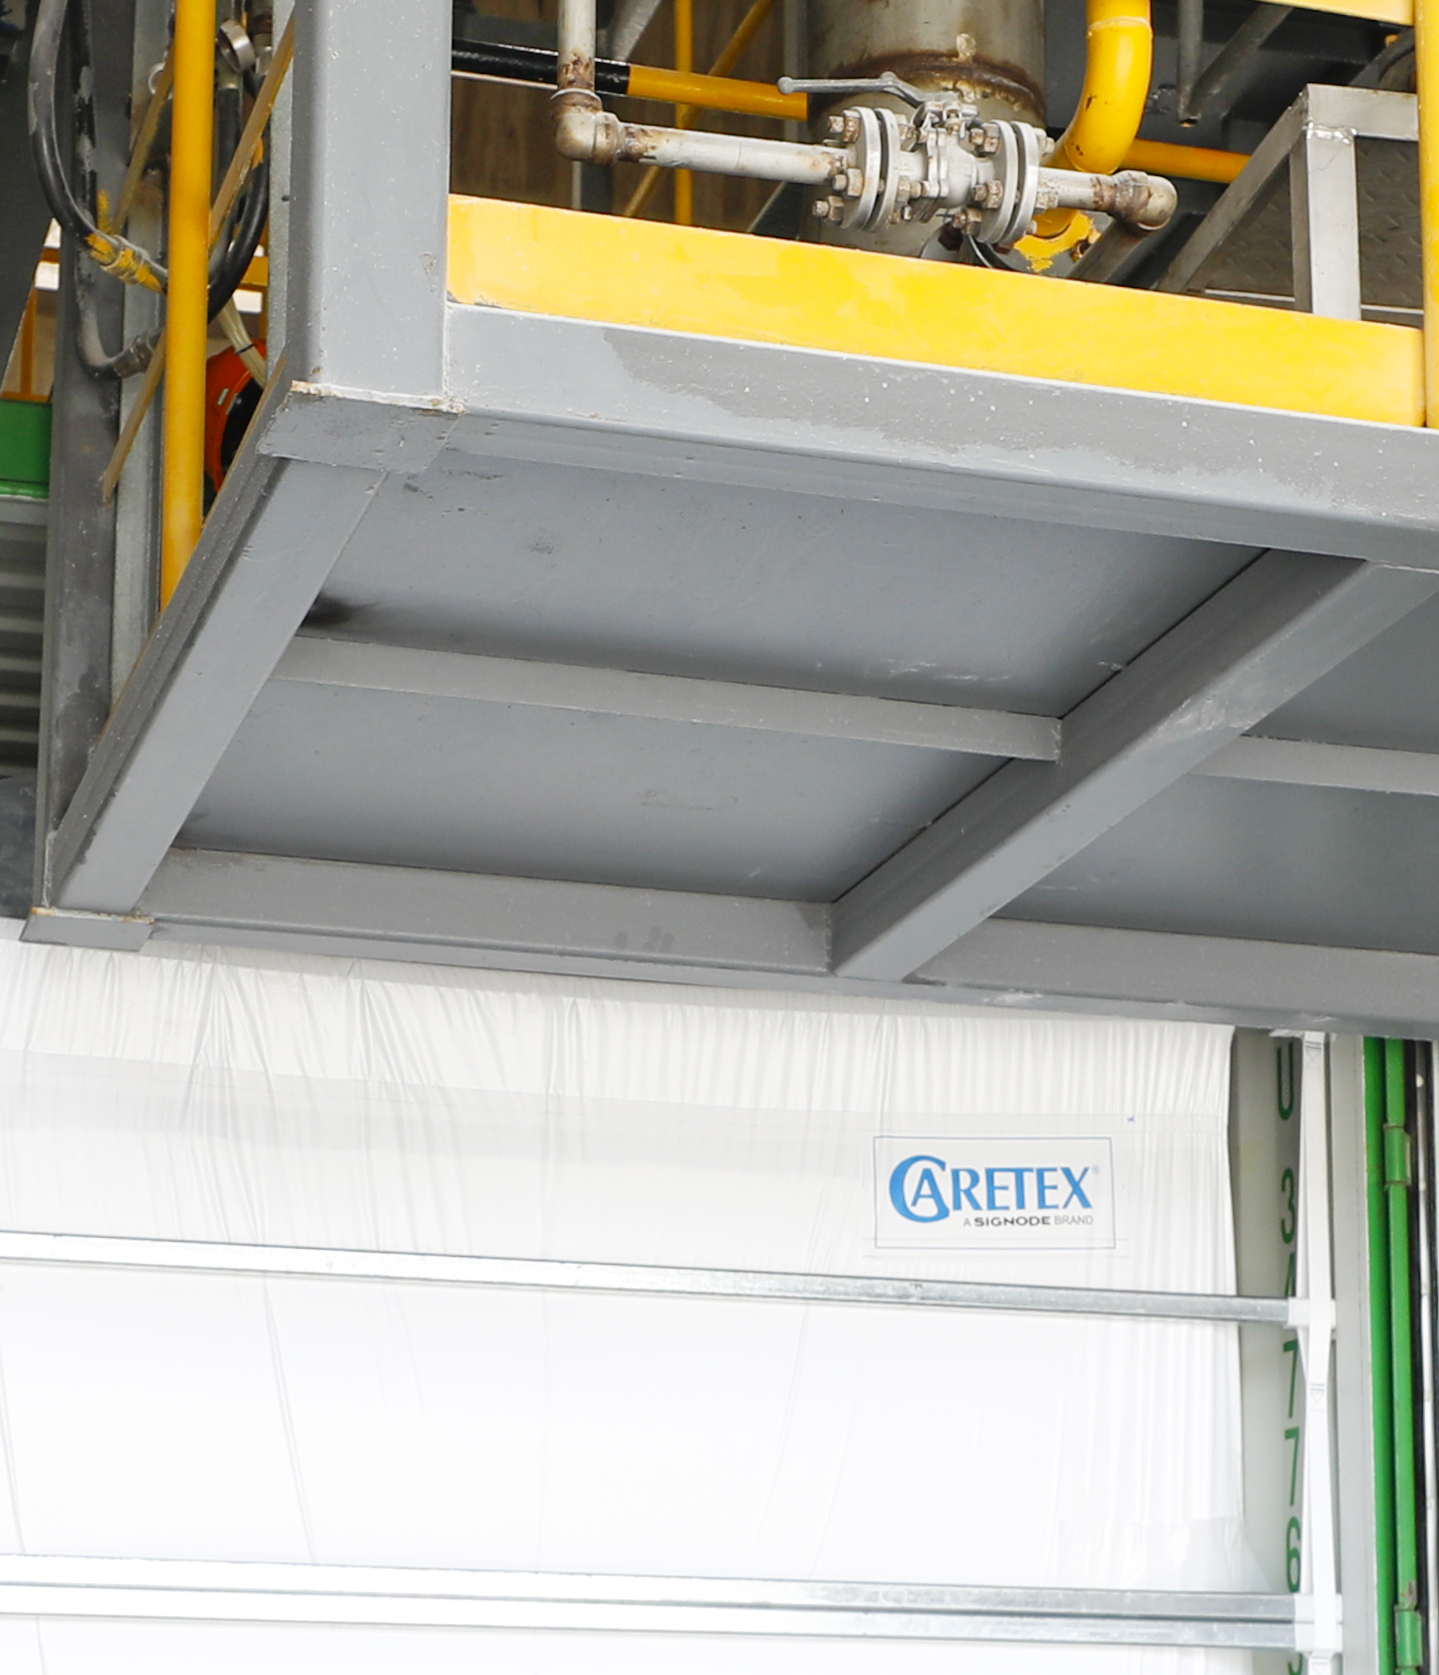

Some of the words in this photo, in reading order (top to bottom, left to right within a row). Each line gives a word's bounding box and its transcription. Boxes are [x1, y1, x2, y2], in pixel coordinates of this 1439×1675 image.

[889, 1155, 1093, 1223] CARETEX
[963, 1218, 972, 1227] A
[974, 1216, 1052, 1228] SIGNODE
[1054, 1214, 1094, 1226] BRAND
